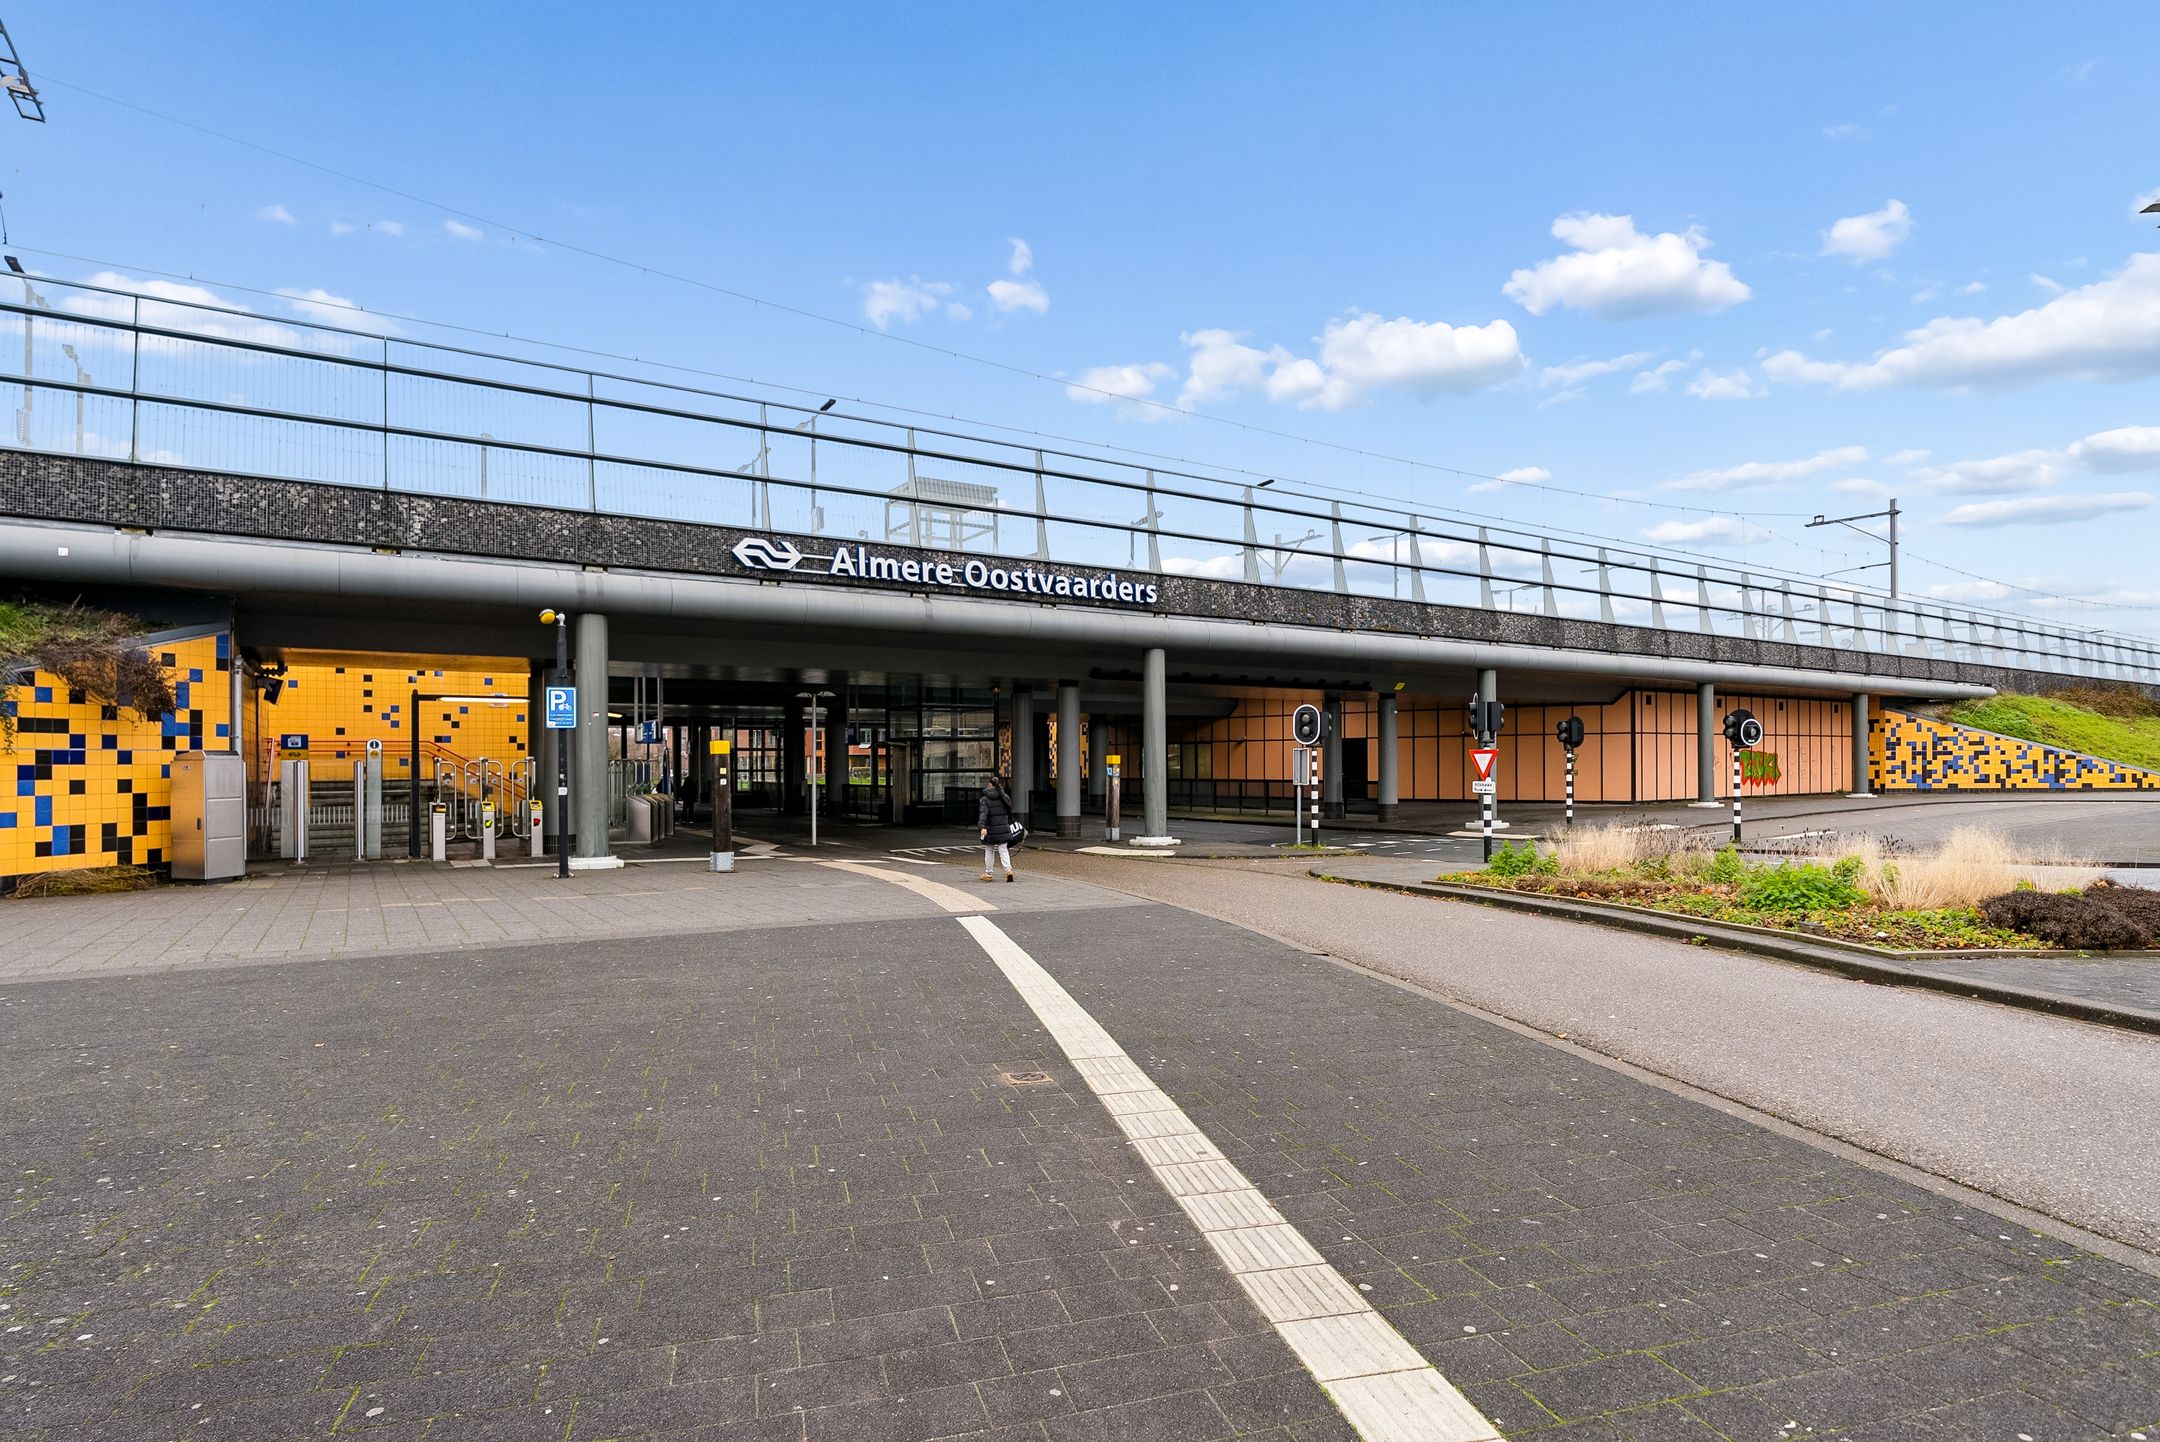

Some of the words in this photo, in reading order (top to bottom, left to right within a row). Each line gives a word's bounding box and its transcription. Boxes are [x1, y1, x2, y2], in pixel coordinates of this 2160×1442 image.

[829, 546, 953, 585] Almere
[963, 560, 1158, 603] Oostvaarders
[551, 690, 566, 711] P
